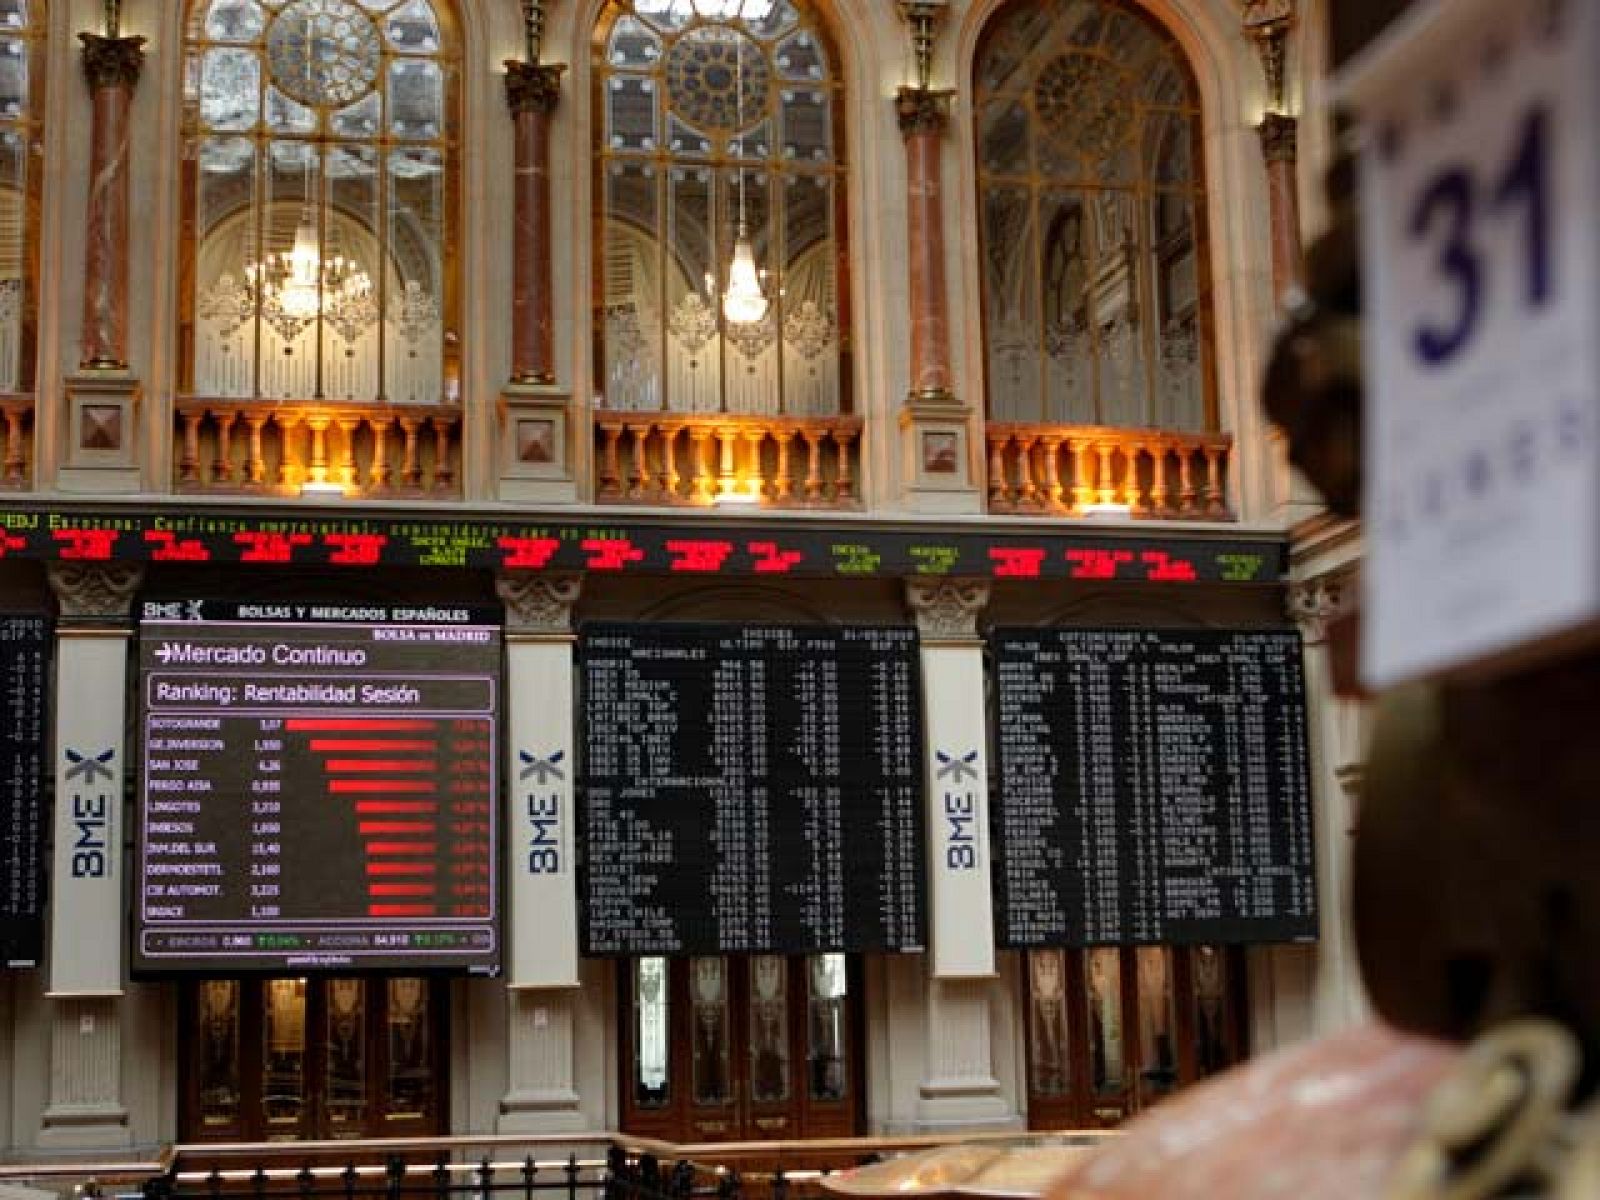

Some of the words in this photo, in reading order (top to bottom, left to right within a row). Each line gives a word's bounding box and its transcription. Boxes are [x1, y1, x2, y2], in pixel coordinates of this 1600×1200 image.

[1407, 98, 1554, 366] 31
[237, 605, 291, 619] BOLSAS
[296, 607, 305, 619] Y
[310, 606, 386, 621] MERCADOS
[392, 606, 470, 622] ESPAÑOLES
[373, 629, 416, 641] BOLSA
[435, 630, 491, 642] MADRID
[171, 644, 266, 664] Mercado
[272, 645, 366, 666] Continuo
[157, 683, 236, 705] Ranking:
[244, 684, 356, 703] Rentabilidad
[361, 685, 420, 704] Sesión
[72, 794, 105, 878] BME
[529, 792, 559, 874] BME
[945, 792, 975, 871] BME
